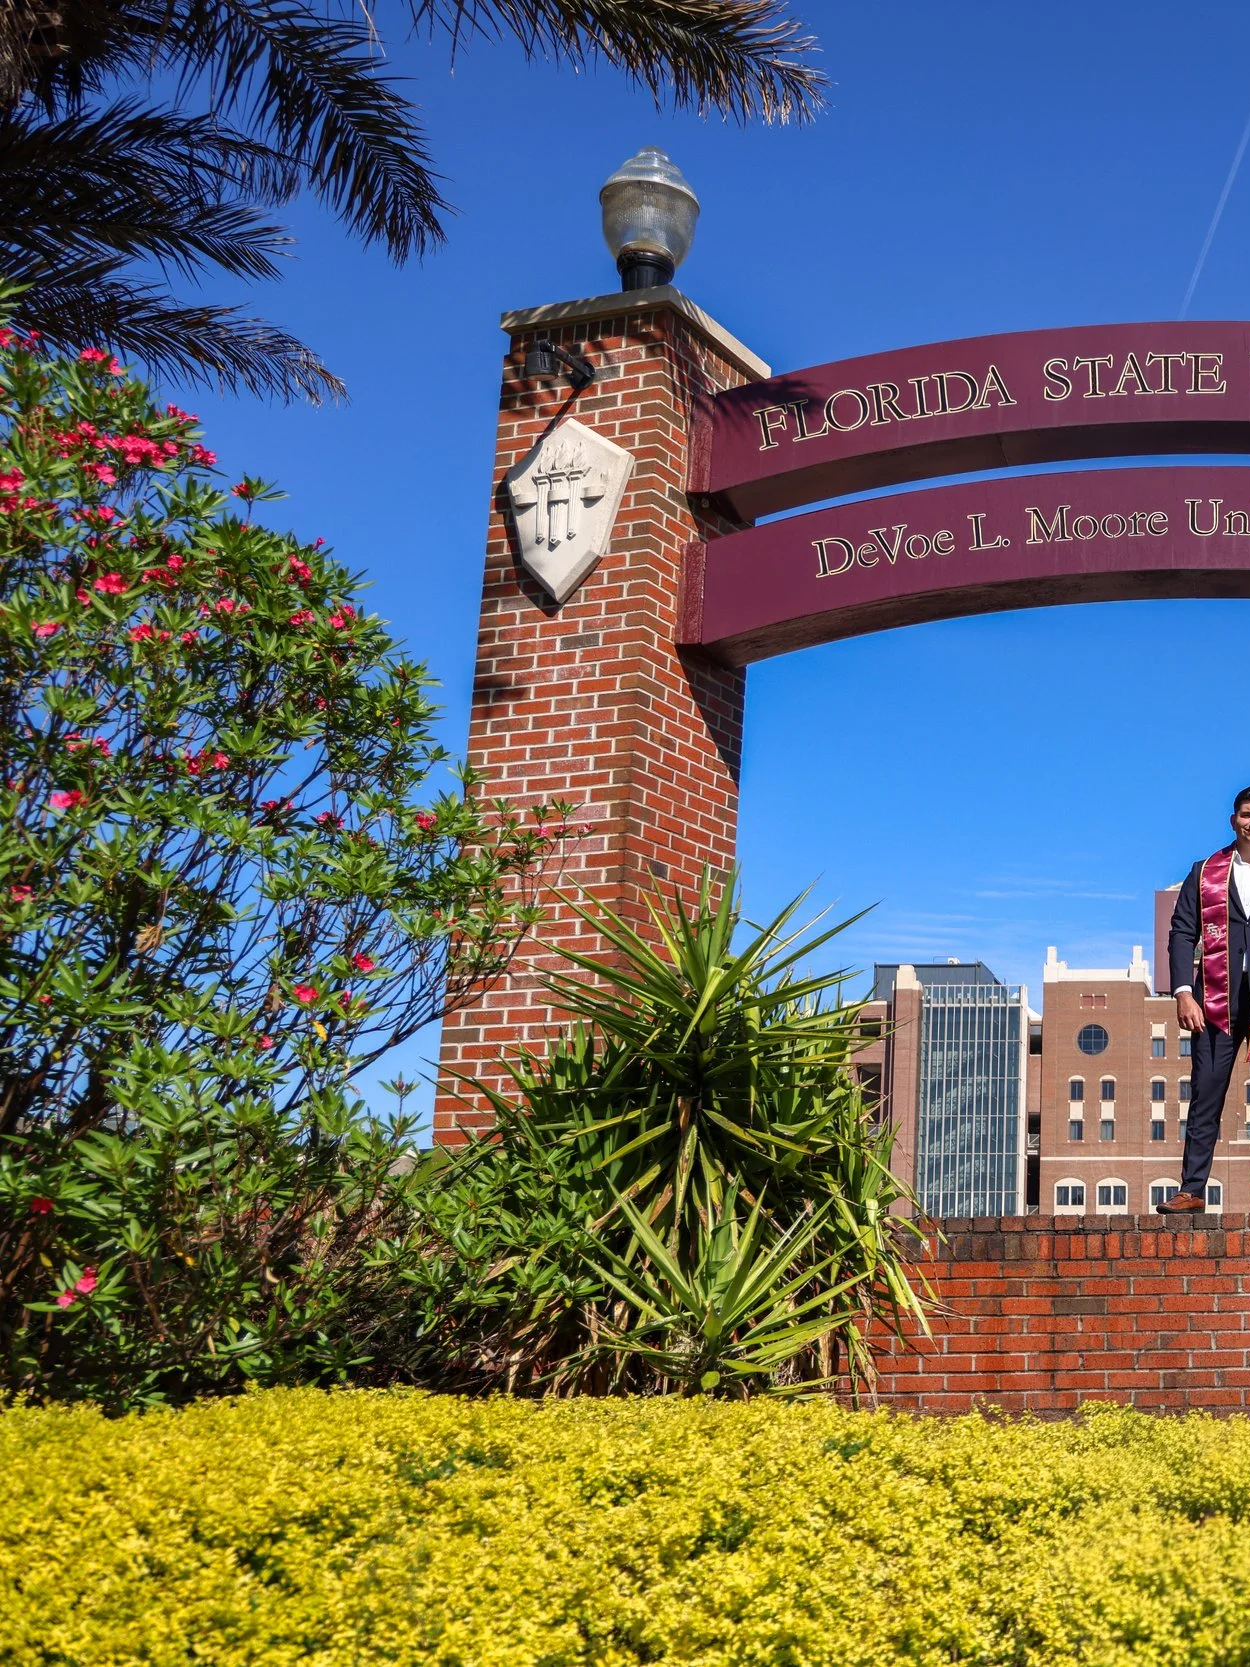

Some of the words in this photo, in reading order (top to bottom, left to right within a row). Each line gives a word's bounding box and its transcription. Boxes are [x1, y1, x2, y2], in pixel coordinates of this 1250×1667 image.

[753, 365, 1016, 451] FLORIDA
[1043, 352, 1227, 401] STATE
[811, 524, 955, 579] DeVoe
[967, 513, 1011, 551] L.
[1025, 505, 1169, 544] Moore
